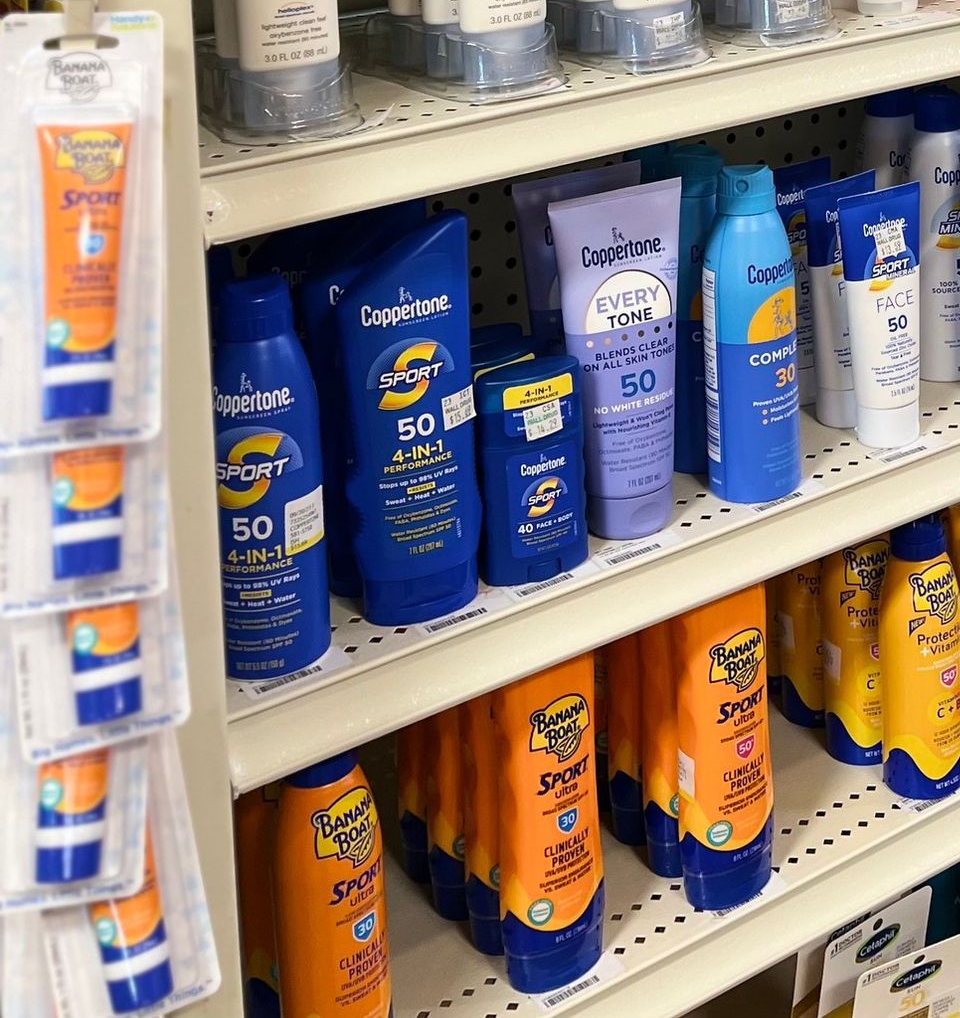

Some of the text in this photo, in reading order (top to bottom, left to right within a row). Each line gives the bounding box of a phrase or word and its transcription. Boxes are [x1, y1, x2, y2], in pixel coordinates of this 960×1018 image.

[50, 57, 106, 77] BANANA
[264, 54, 279, 63] 3.0
[279, 53, 289, 62] FL
[290, 51, 302, 61] OZ
[60, 73, 96, 88] BOAT
[61, 190, 121, 210] SPORT
[582, 237, 661, 269] Coppertone
[361, 293, 449, 327] Coppertone
[596, 285, 660, 314] EVERY
[877, 289, 914, 313] FACE
[607, 308, 653, 328] TONE
[887, 315, 908, 332] 50
[595, 337, 669, 361] BLENDS CLEAR
[379, 363, 440, 389] SPORT
[620, 369, 656, 398] 50
[397, 414, 434, 440] 50
[384, 451, 452, 474] PERFORMANCE
[392, 440, 443, 463] 4-IN-1
[215, 457, 289, 481] SPORT
[521, 456, 566, 477] Coppertone
[385, 497, 405, 506] Sweat
[437, 483, 455, 493] Water
[528, 488, 561, 506] SPORT
[232, 516, 273, 541] 50
[518, 513, 573, 534] 40 FACE BODY
[228, 545, 282, 564] 4-IN-1
[715, 635, 761, 666] BANANA
[717, 688, 765, 724] SPORT
[533, 700, 586, 737] BANANA
[733, 710, 755, 727] ultra
[537, 756, 588, 796] SPORT
[723, 752, 764, 782] CLINICALLY
[555, 782, 578, 799] ultra
[731, 770, 760, 791] PROVEN
[316, 793, 372, 839] BANANA
[561, 813, 575, 827] 30
[544, 827, 589, 858] CLINICALLY
[552, 842, 585, 867] PROVEN
[329, 856, 381, 906] SPORT
[350, 885, 374, 907] ultra
[860, 930, 896, 958] Cetaphil
[896, 964, 941, 988] Cetaphil
